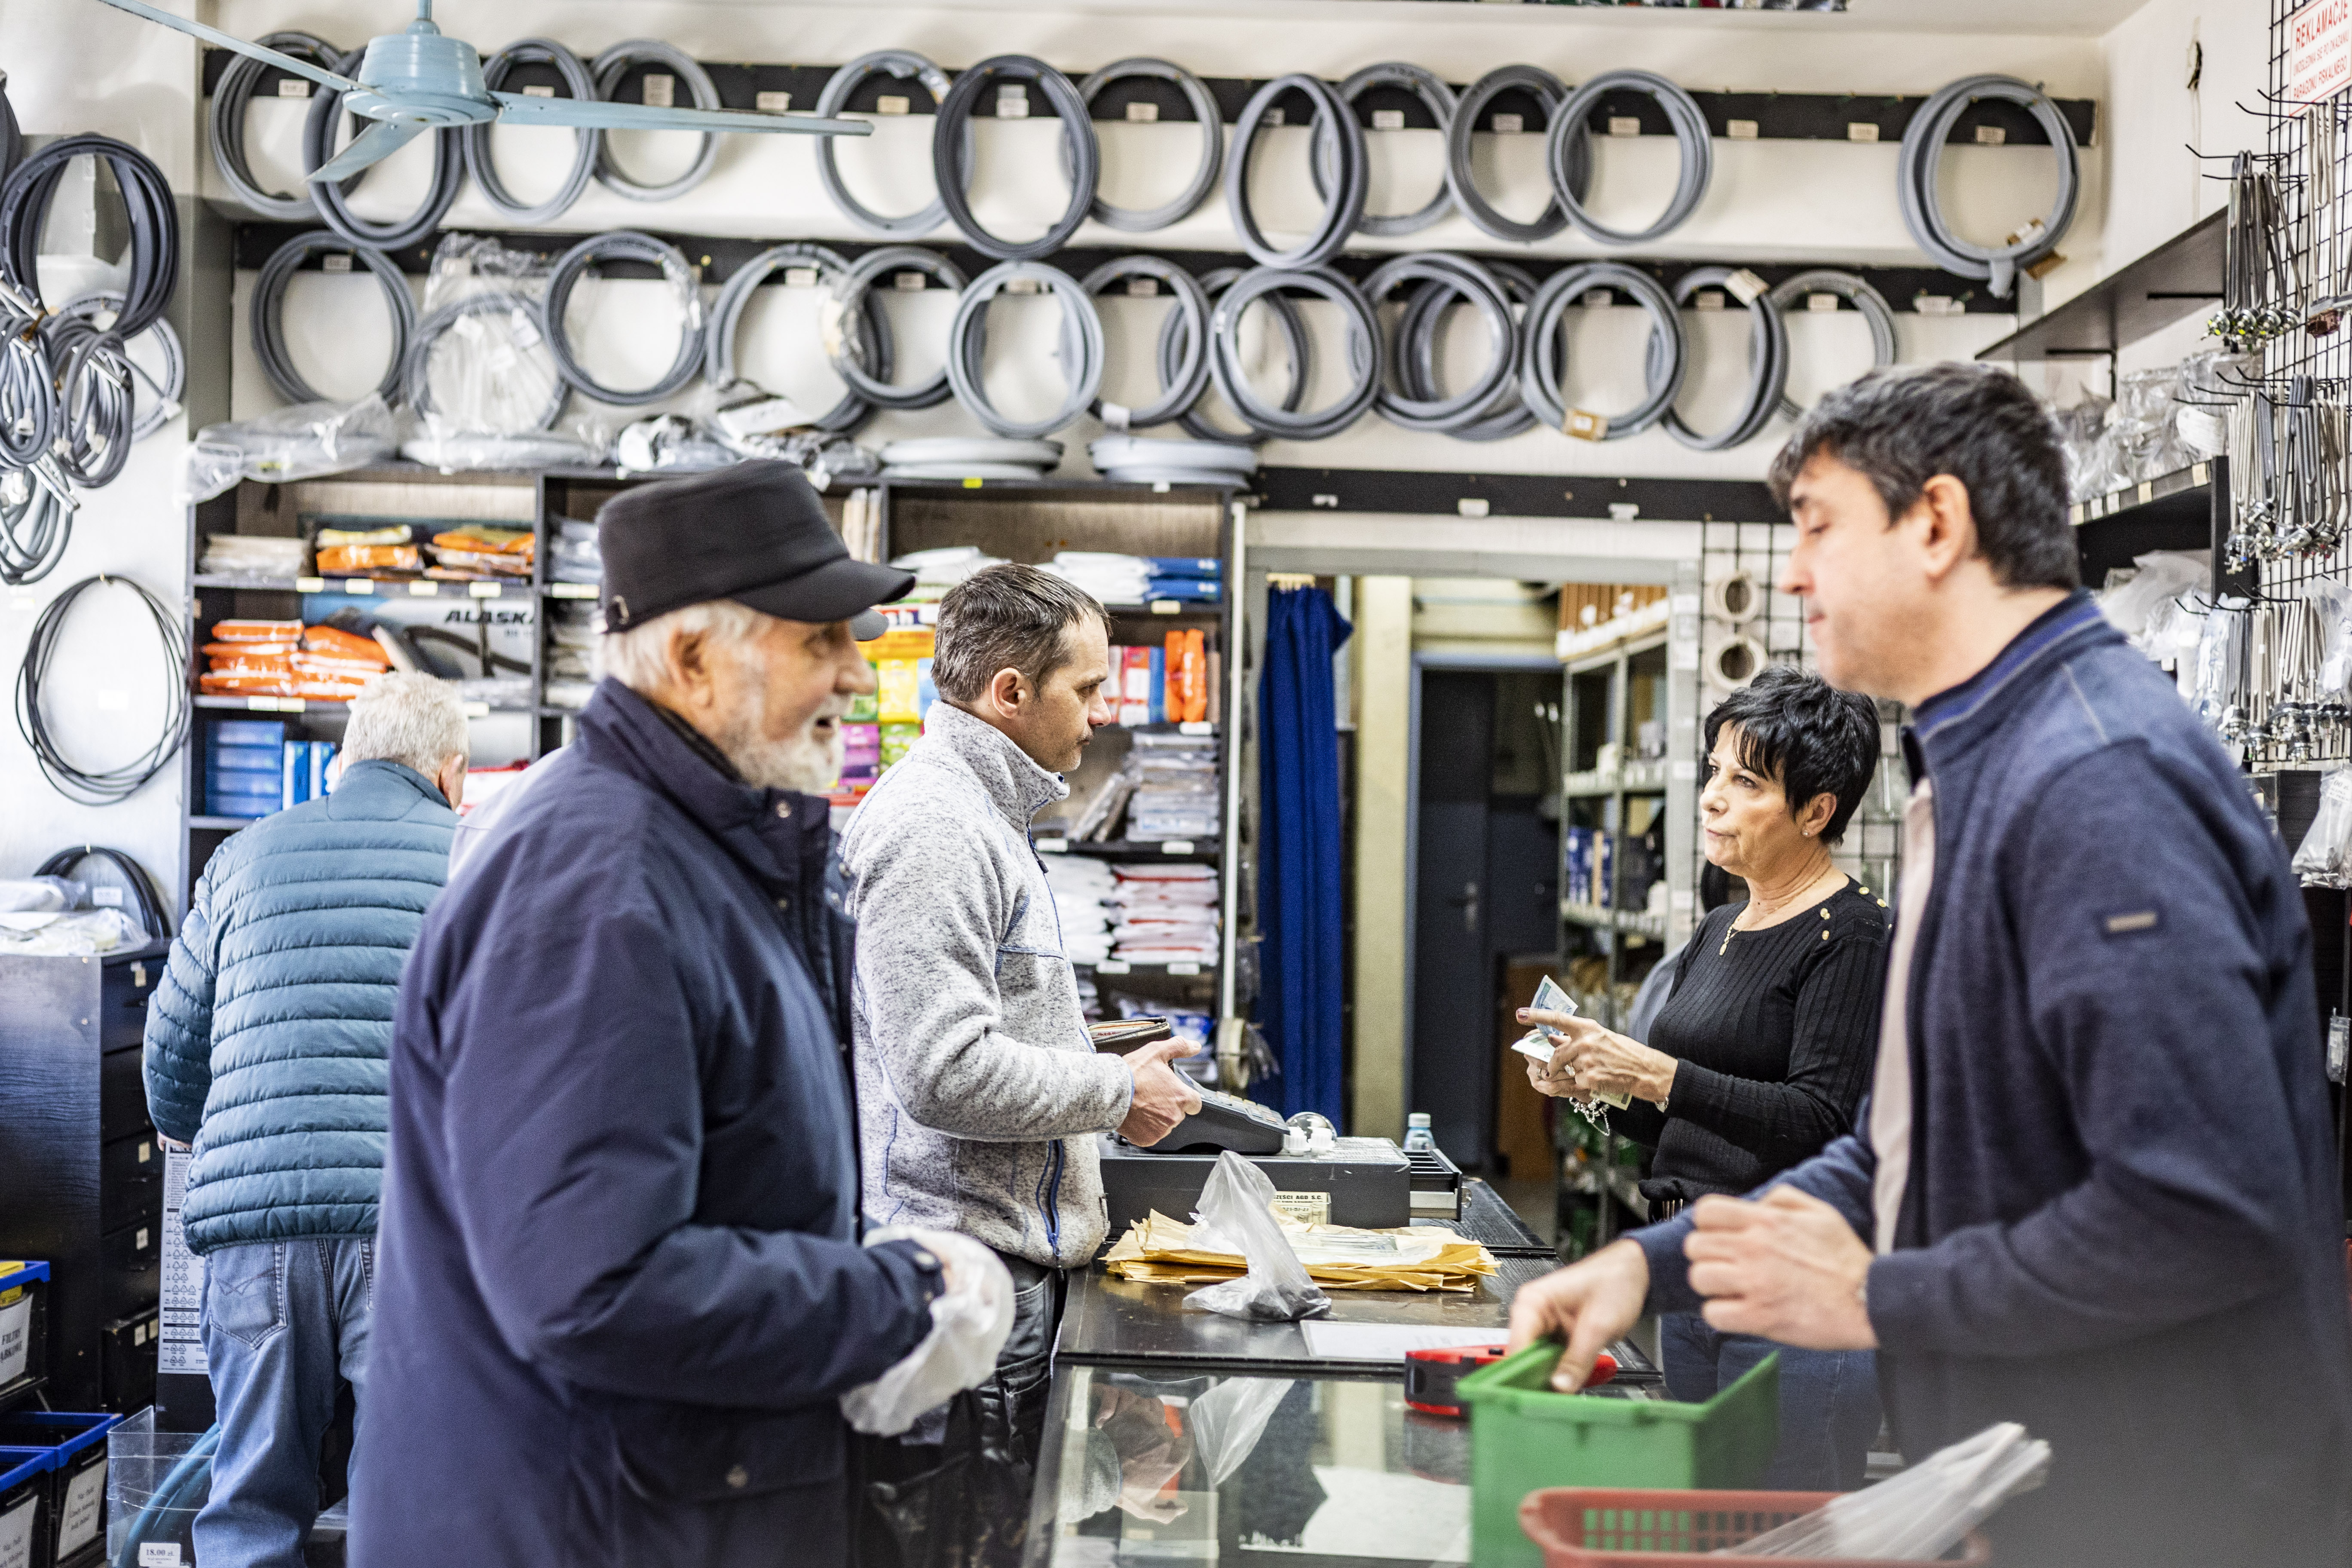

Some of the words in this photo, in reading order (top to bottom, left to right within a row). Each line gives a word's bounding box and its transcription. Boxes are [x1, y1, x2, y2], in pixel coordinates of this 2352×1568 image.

[2296, 0, 2348, 51] REKLAMACJE
[2294, 74, 2318, 102] PARAGONU
[2318, 55, 2347, 86] FISKALNEGO
